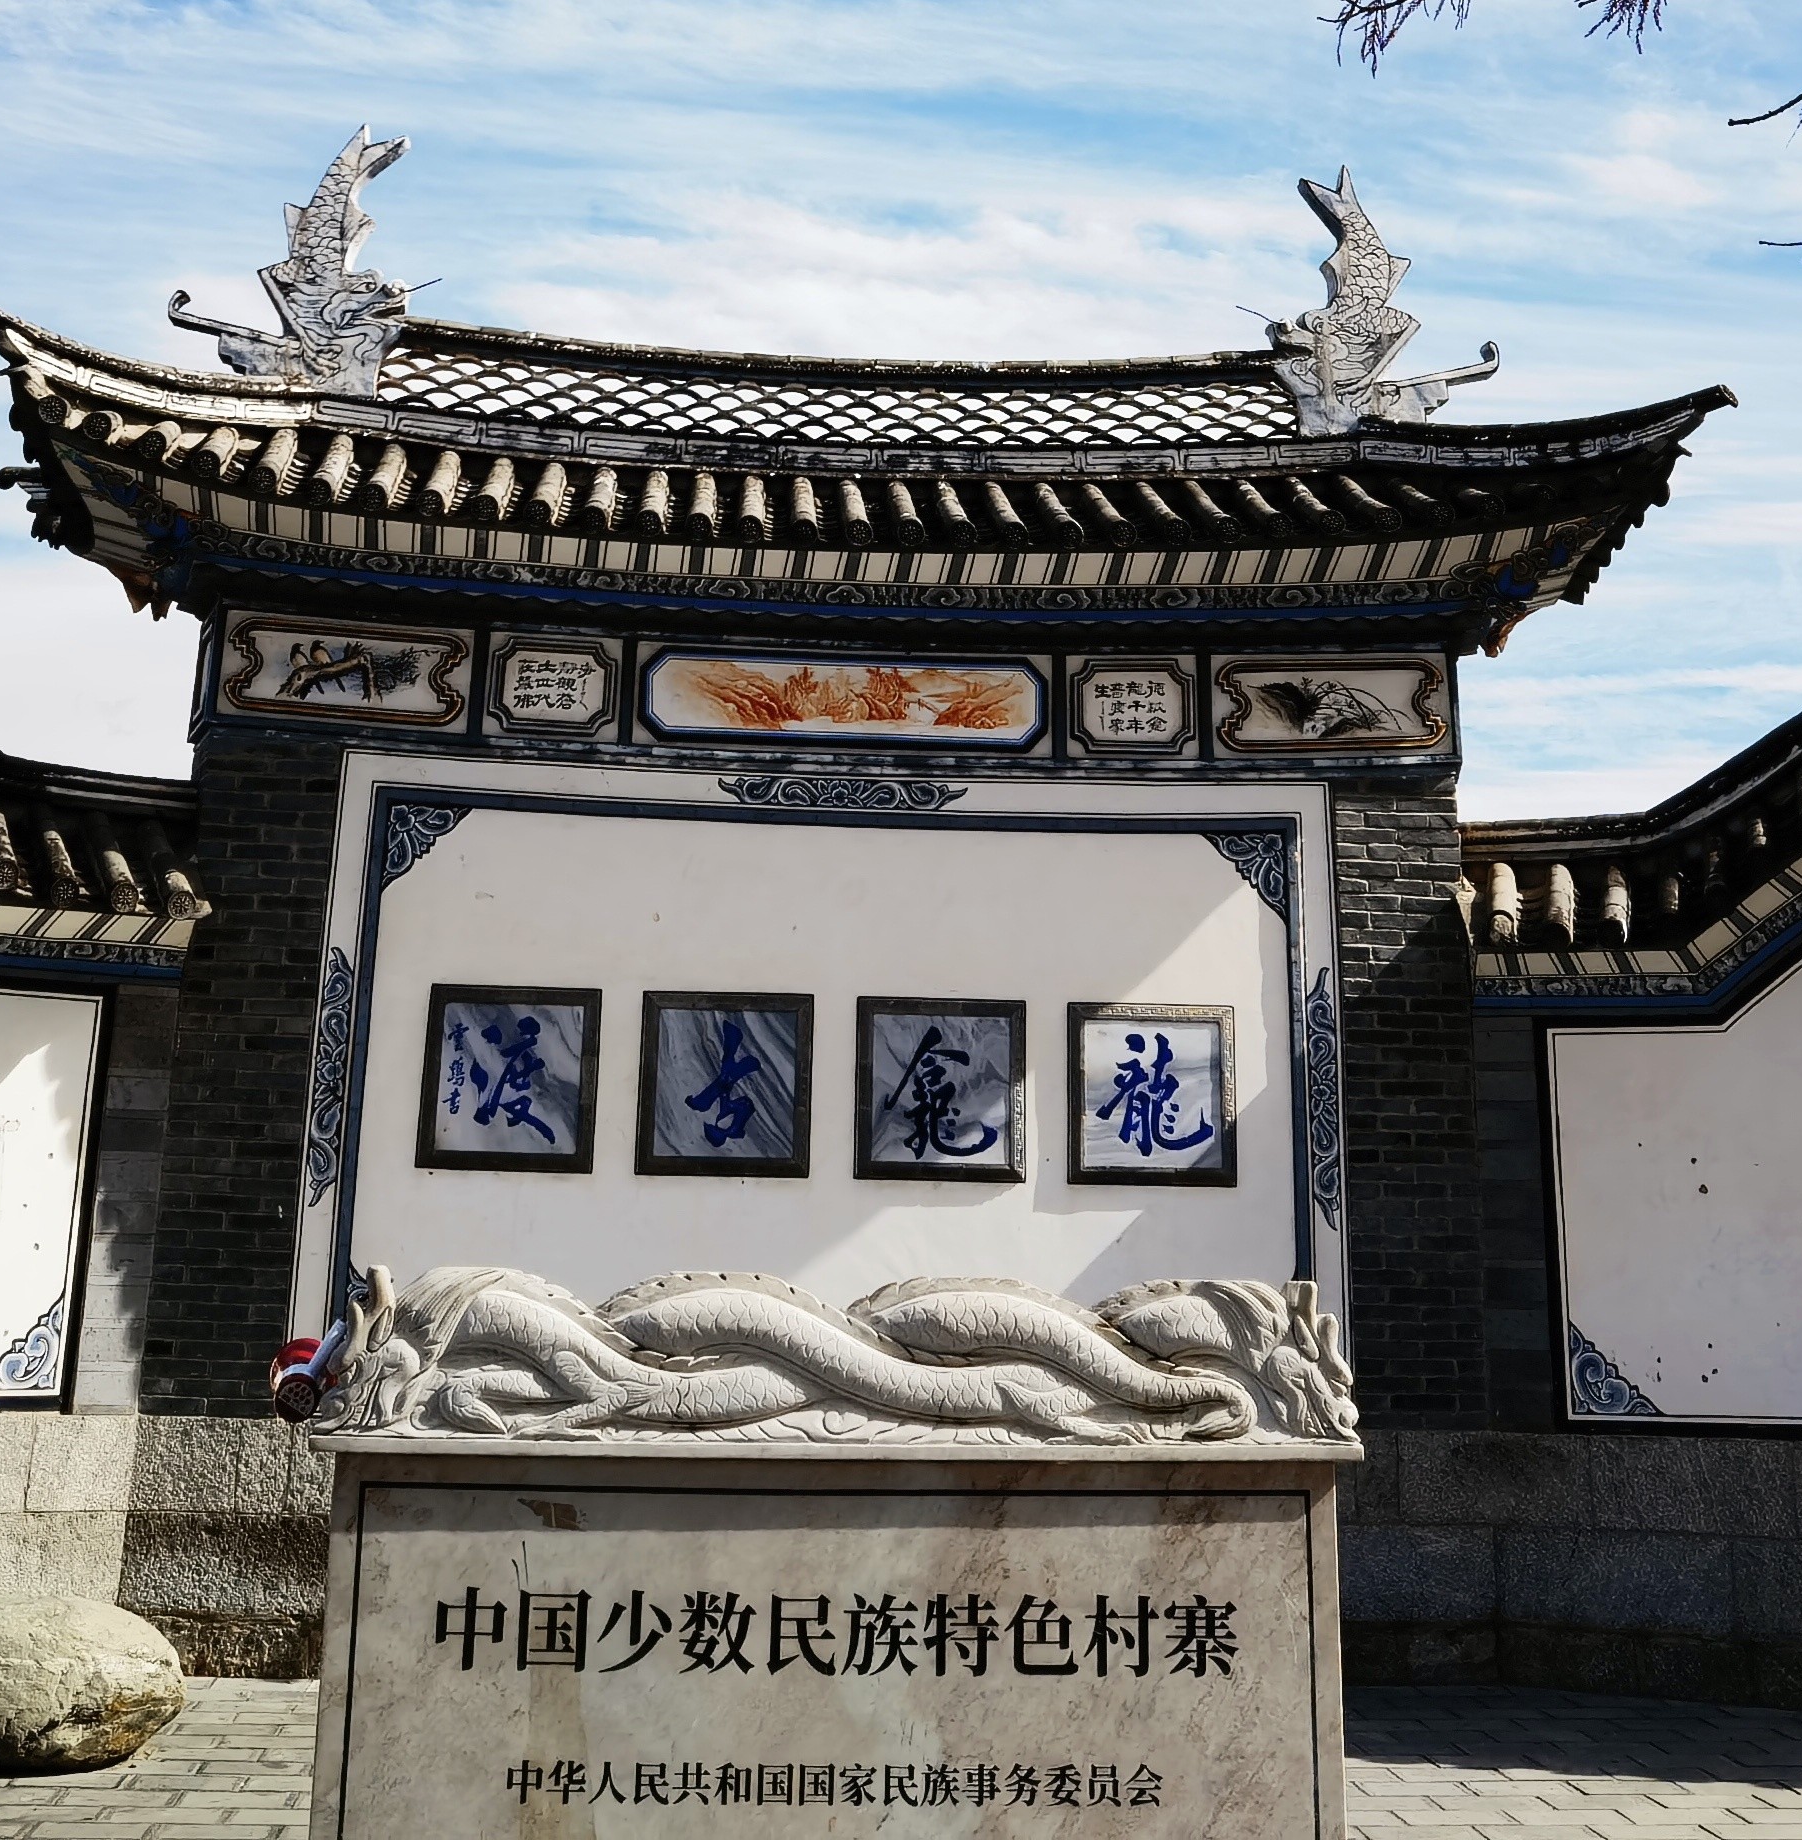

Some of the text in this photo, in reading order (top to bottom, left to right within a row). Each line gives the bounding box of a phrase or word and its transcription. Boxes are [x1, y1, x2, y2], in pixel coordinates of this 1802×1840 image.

[433, 1584, 1241, 1682] 中国少数民族特色村寨
[504, 1760, 1165, 1809] 中华人民共和国国家民族事务委员会
